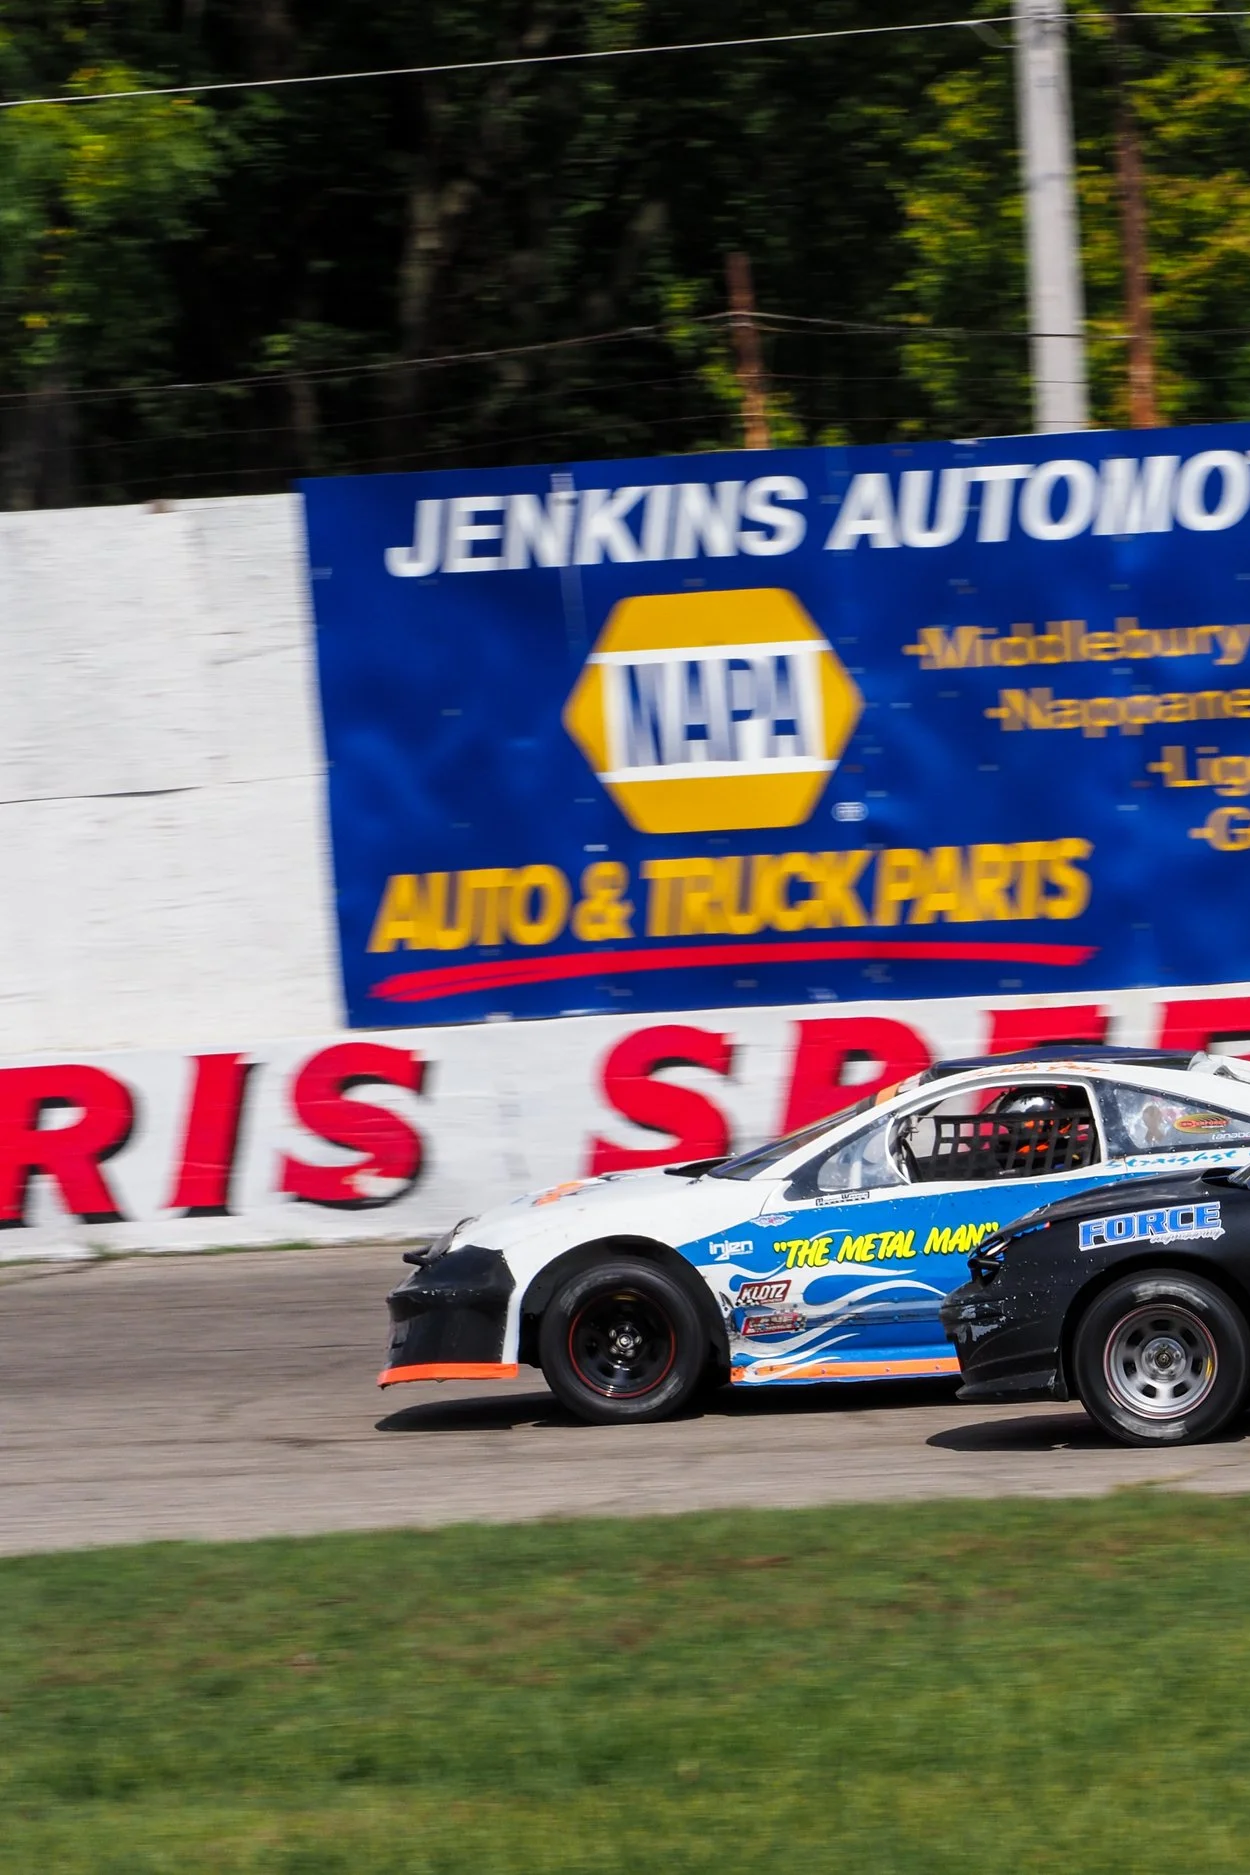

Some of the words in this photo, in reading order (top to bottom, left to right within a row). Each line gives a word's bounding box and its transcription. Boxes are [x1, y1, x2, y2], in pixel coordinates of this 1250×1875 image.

[385, 475, 808, 577] JENKINS
[618, 654, 806, 768] NAPA
[366, 864, 571, 953] AUTO
[572, 861, 636, 942] &
[640, 849, 870, 938] TRUCK
[873, 837, 1095, 925] PARTS
[773, 1236, 834, 1269] "THE
[836, 1228, 917, 1264] METAL
[923, 1221, 1000, 1255] MAN"
[1080, 1202, 1221, 1250] FORCE
[709, 1240, 754, 1262] injen
[741, 1283, 788, 1301] KLOTZ
